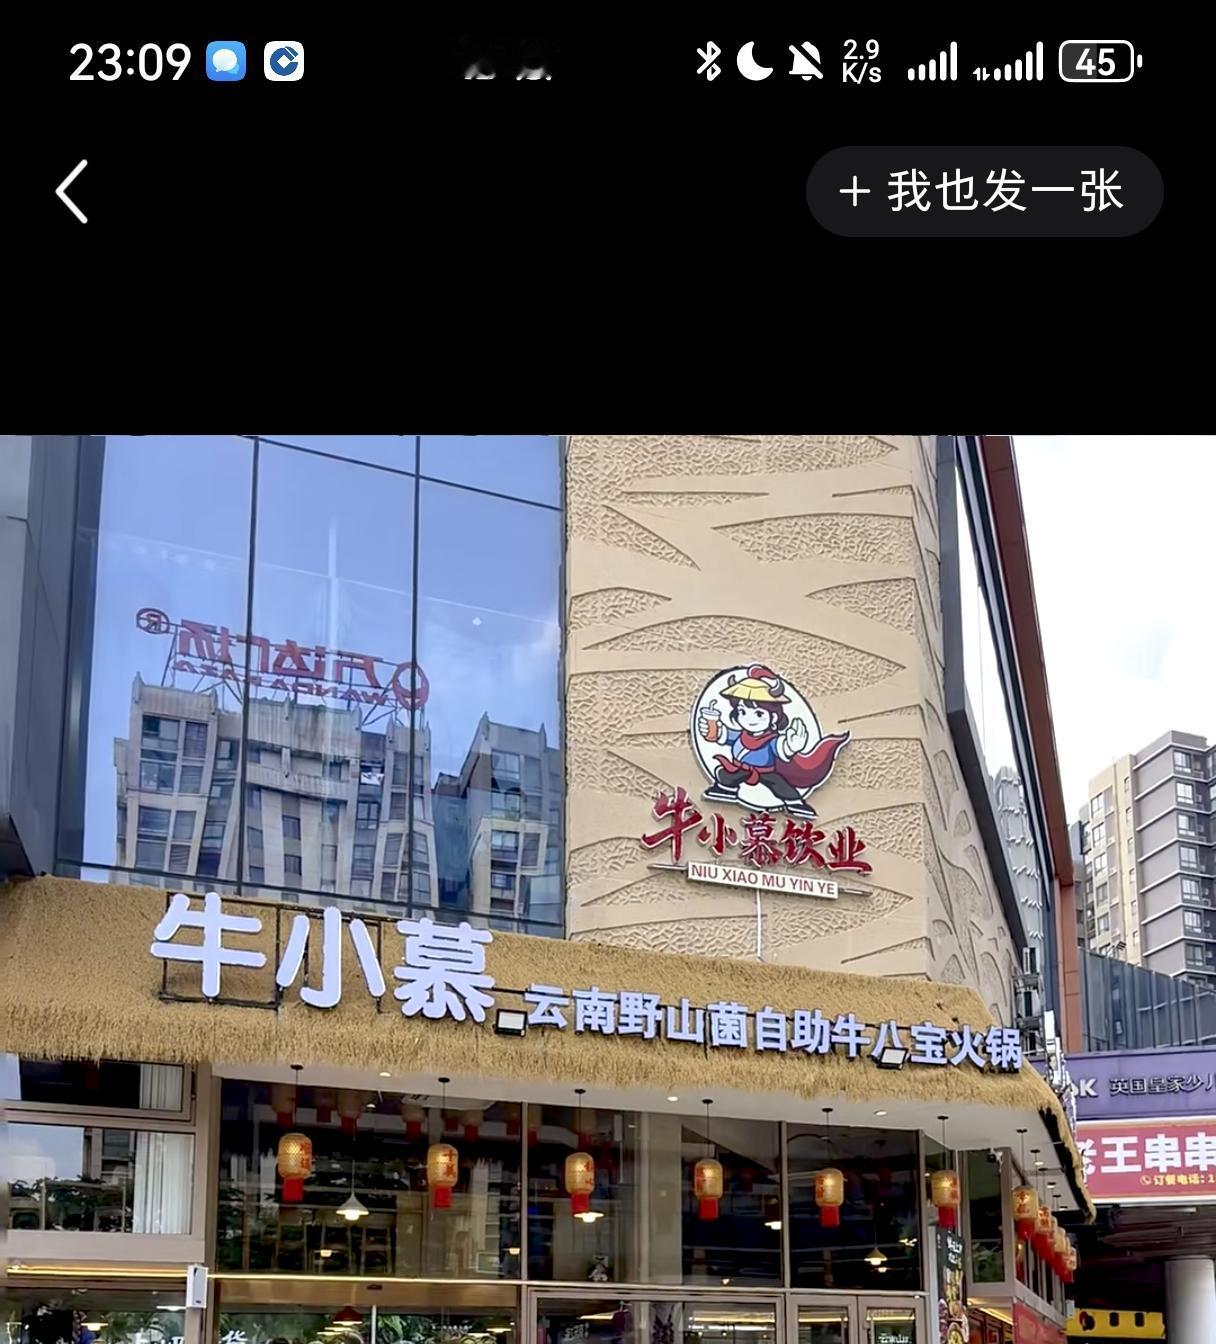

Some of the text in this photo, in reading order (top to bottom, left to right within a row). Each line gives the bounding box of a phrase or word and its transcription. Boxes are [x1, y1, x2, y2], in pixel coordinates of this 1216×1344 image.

[641, 786, 873, 876] 牛小慕饮业
[691, 864, 836, 895] NIU XIAO MU YIN YE
[150, 892, 496, 1023] 牛小慕
[525, 983, 1023, 1071] 云南野山菌自助牛八宝火锅
